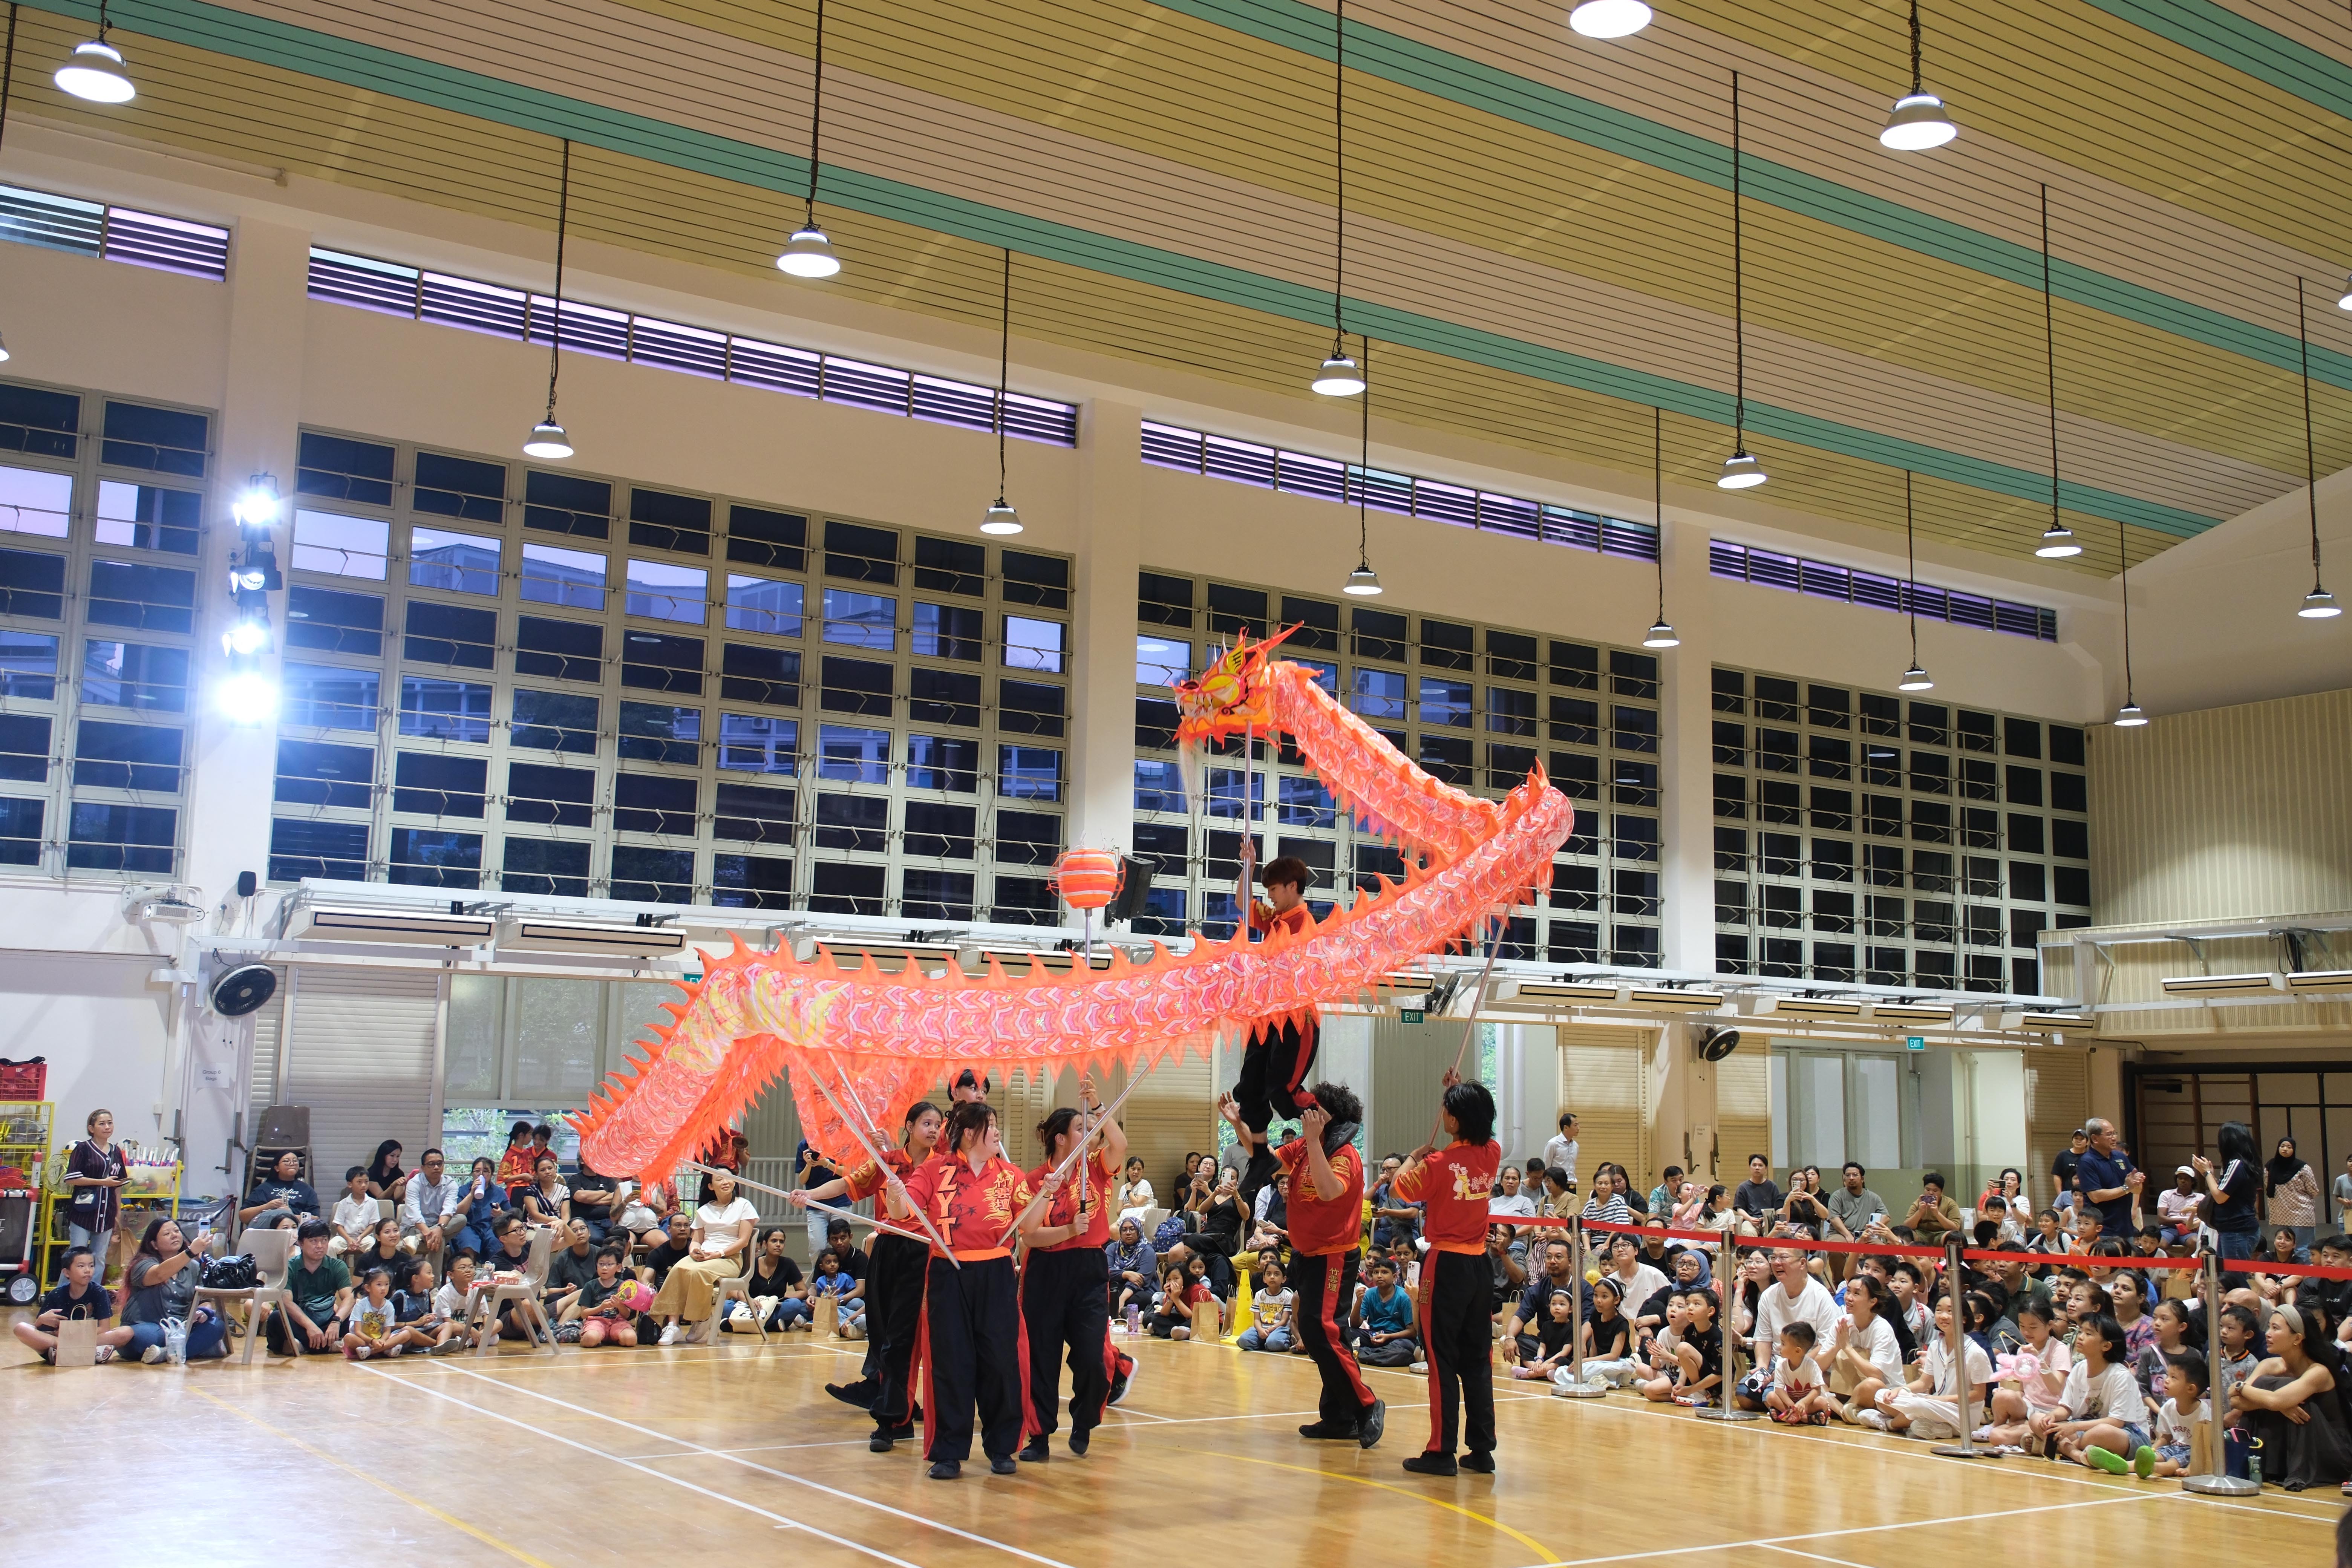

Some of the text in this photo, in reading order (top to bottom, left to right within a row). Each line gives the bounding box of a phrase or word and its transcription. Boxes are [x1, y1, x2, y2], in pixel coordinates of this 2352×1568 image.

[1405, 1012, 1419, 1021] EXIT
[1910, 1039, 1920, 1047] EXIT
[110, 1163, 121, 1175] NY
[993, 1178, 1011, 1211] 竹雲壇
[935, 1165, 957, 1245] ZYT
